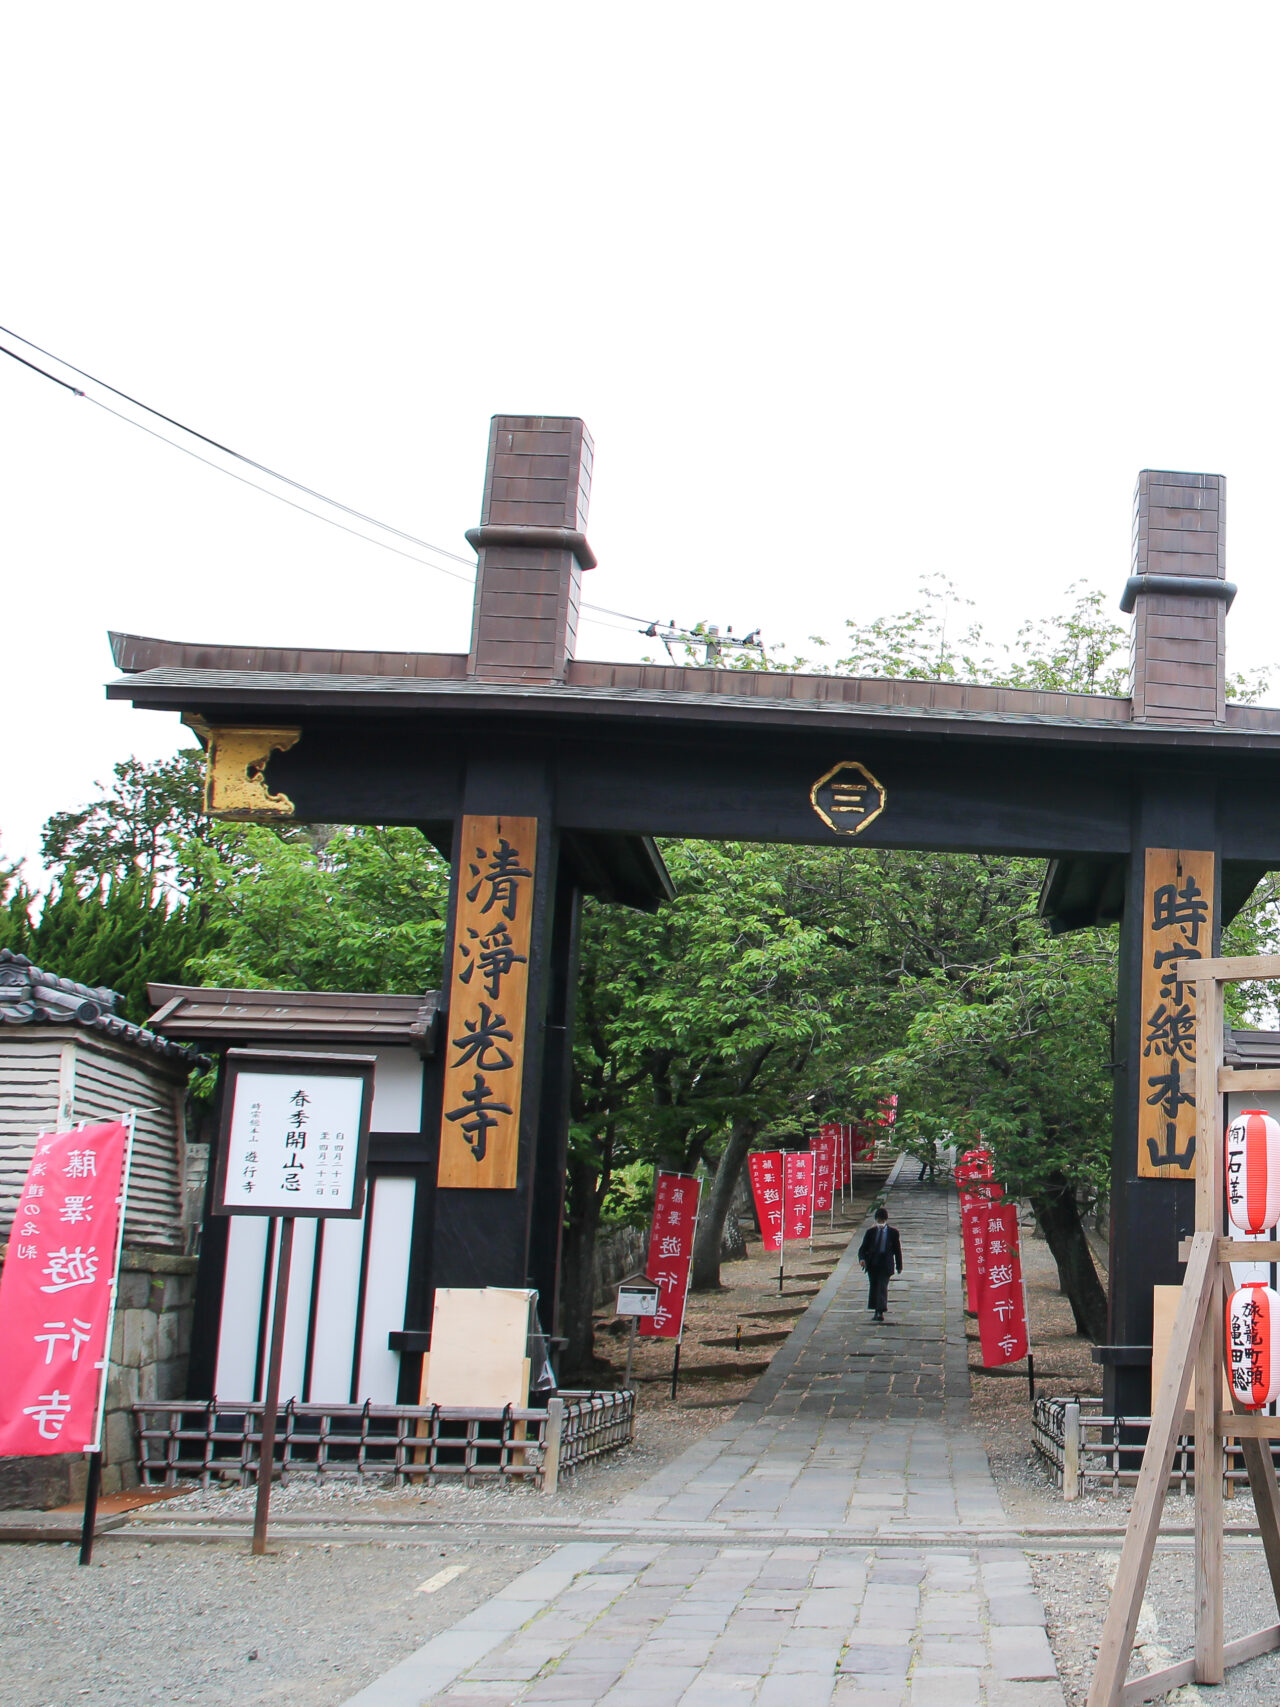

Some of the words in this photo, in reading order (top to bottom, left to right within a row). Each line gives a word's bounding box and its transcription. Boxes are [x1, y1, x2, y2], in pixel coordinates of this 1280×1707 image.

[280, 1089, 312, 1192] 春季開山忌
